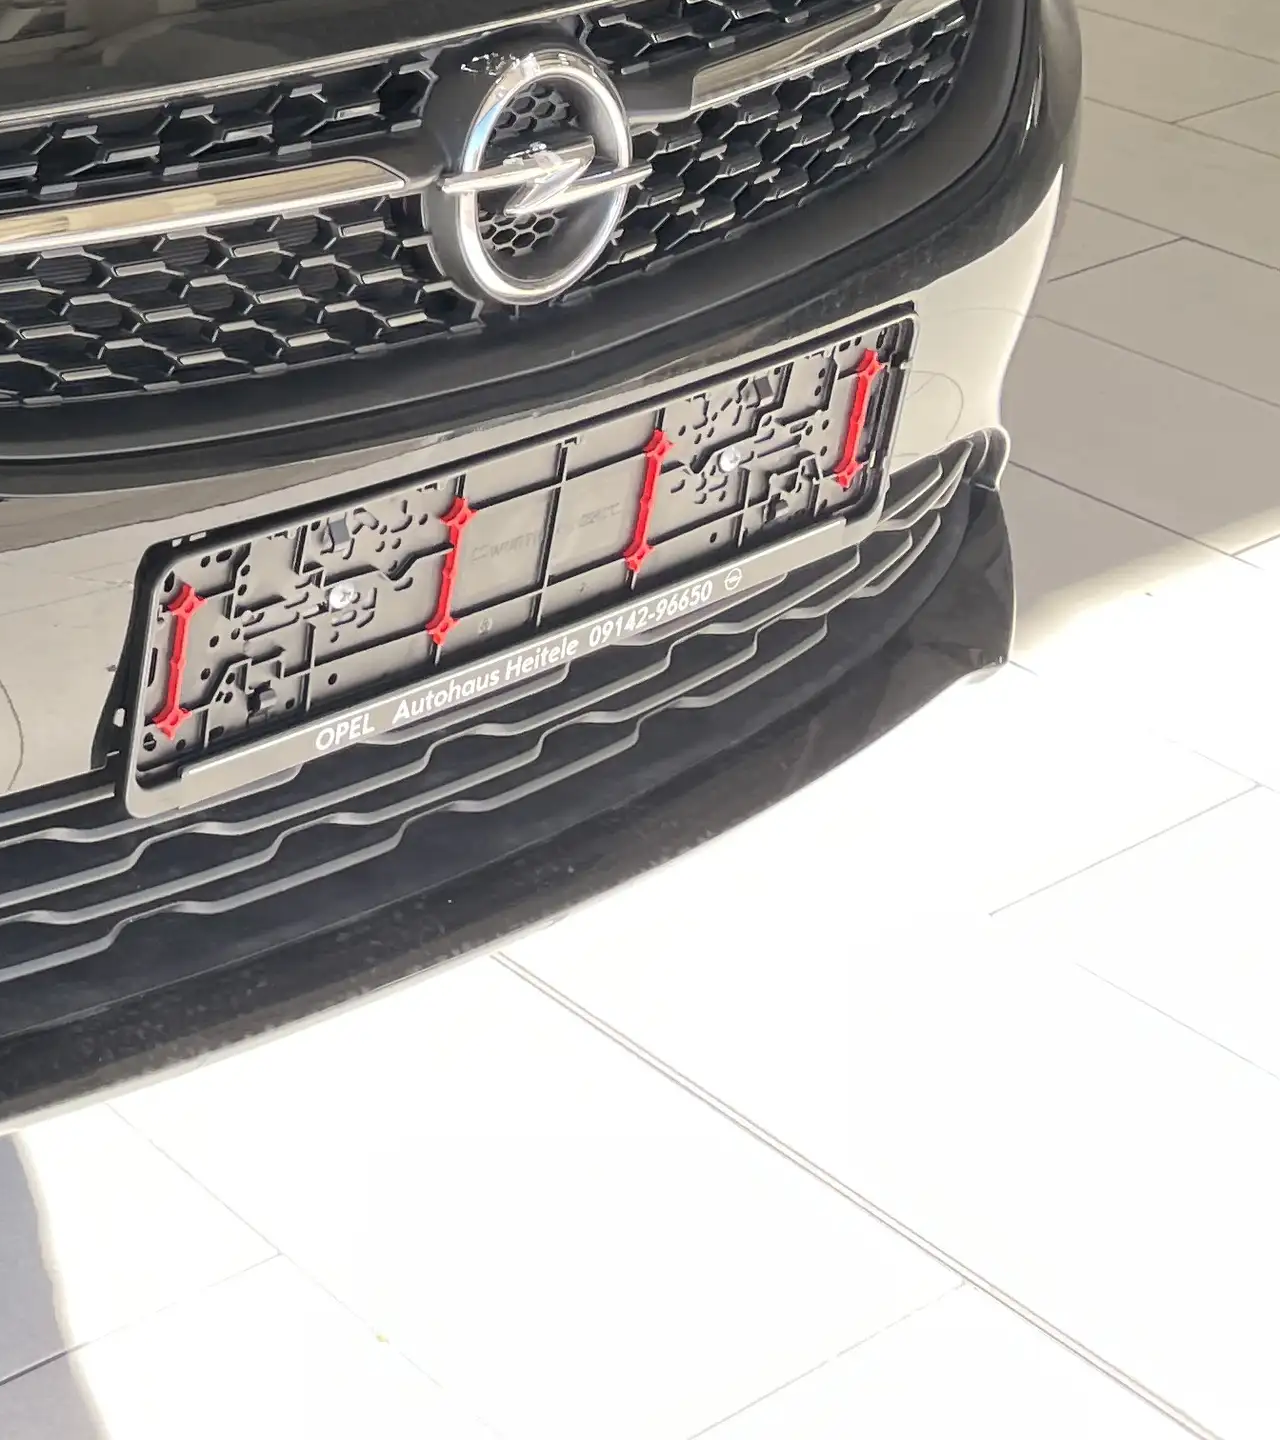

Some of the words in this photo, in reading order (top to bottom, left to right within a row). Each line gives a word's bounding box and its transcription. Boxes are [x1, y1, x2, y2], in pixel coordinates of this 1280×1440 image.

[315, 713, 376, 751] OPEL
[392, 669, 501, 725] Autohaus
[505, 636, 579, 681] Heitele
[589, 579, 713, 648] 09142-96650
